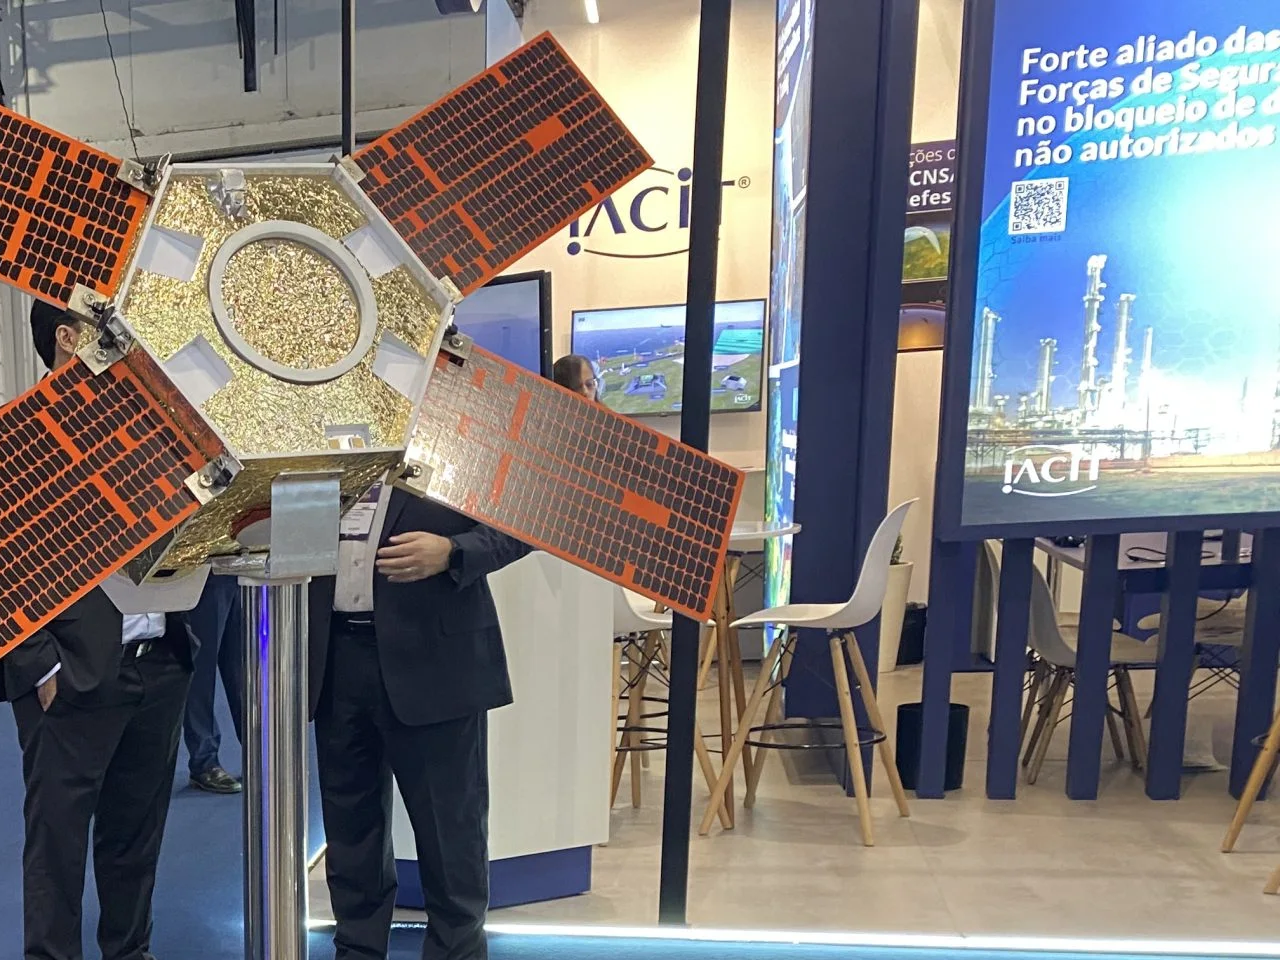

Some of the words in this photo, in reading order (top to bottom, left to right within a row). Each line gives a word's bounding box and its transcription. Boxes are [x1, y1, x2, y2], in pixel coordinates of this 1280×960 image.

[1022, 44, 1109, 74] Forte
[1115, 30, 1218, 66] aliado
[1019, 76, 1125, 106] Forças
[1130, 66, 1174, 95] de
[1016, 113, 1057, 137] no
[1063, 95, 1208, 132] bloqueio
[1212, 89, 1257, 120] de
[1014, 140, 1073, 168] não
[1079, 121, 1277, 162] autorizados
[1010, 234, 1037, 245] Saiba
[1039, 233, 1062, 242] mais
